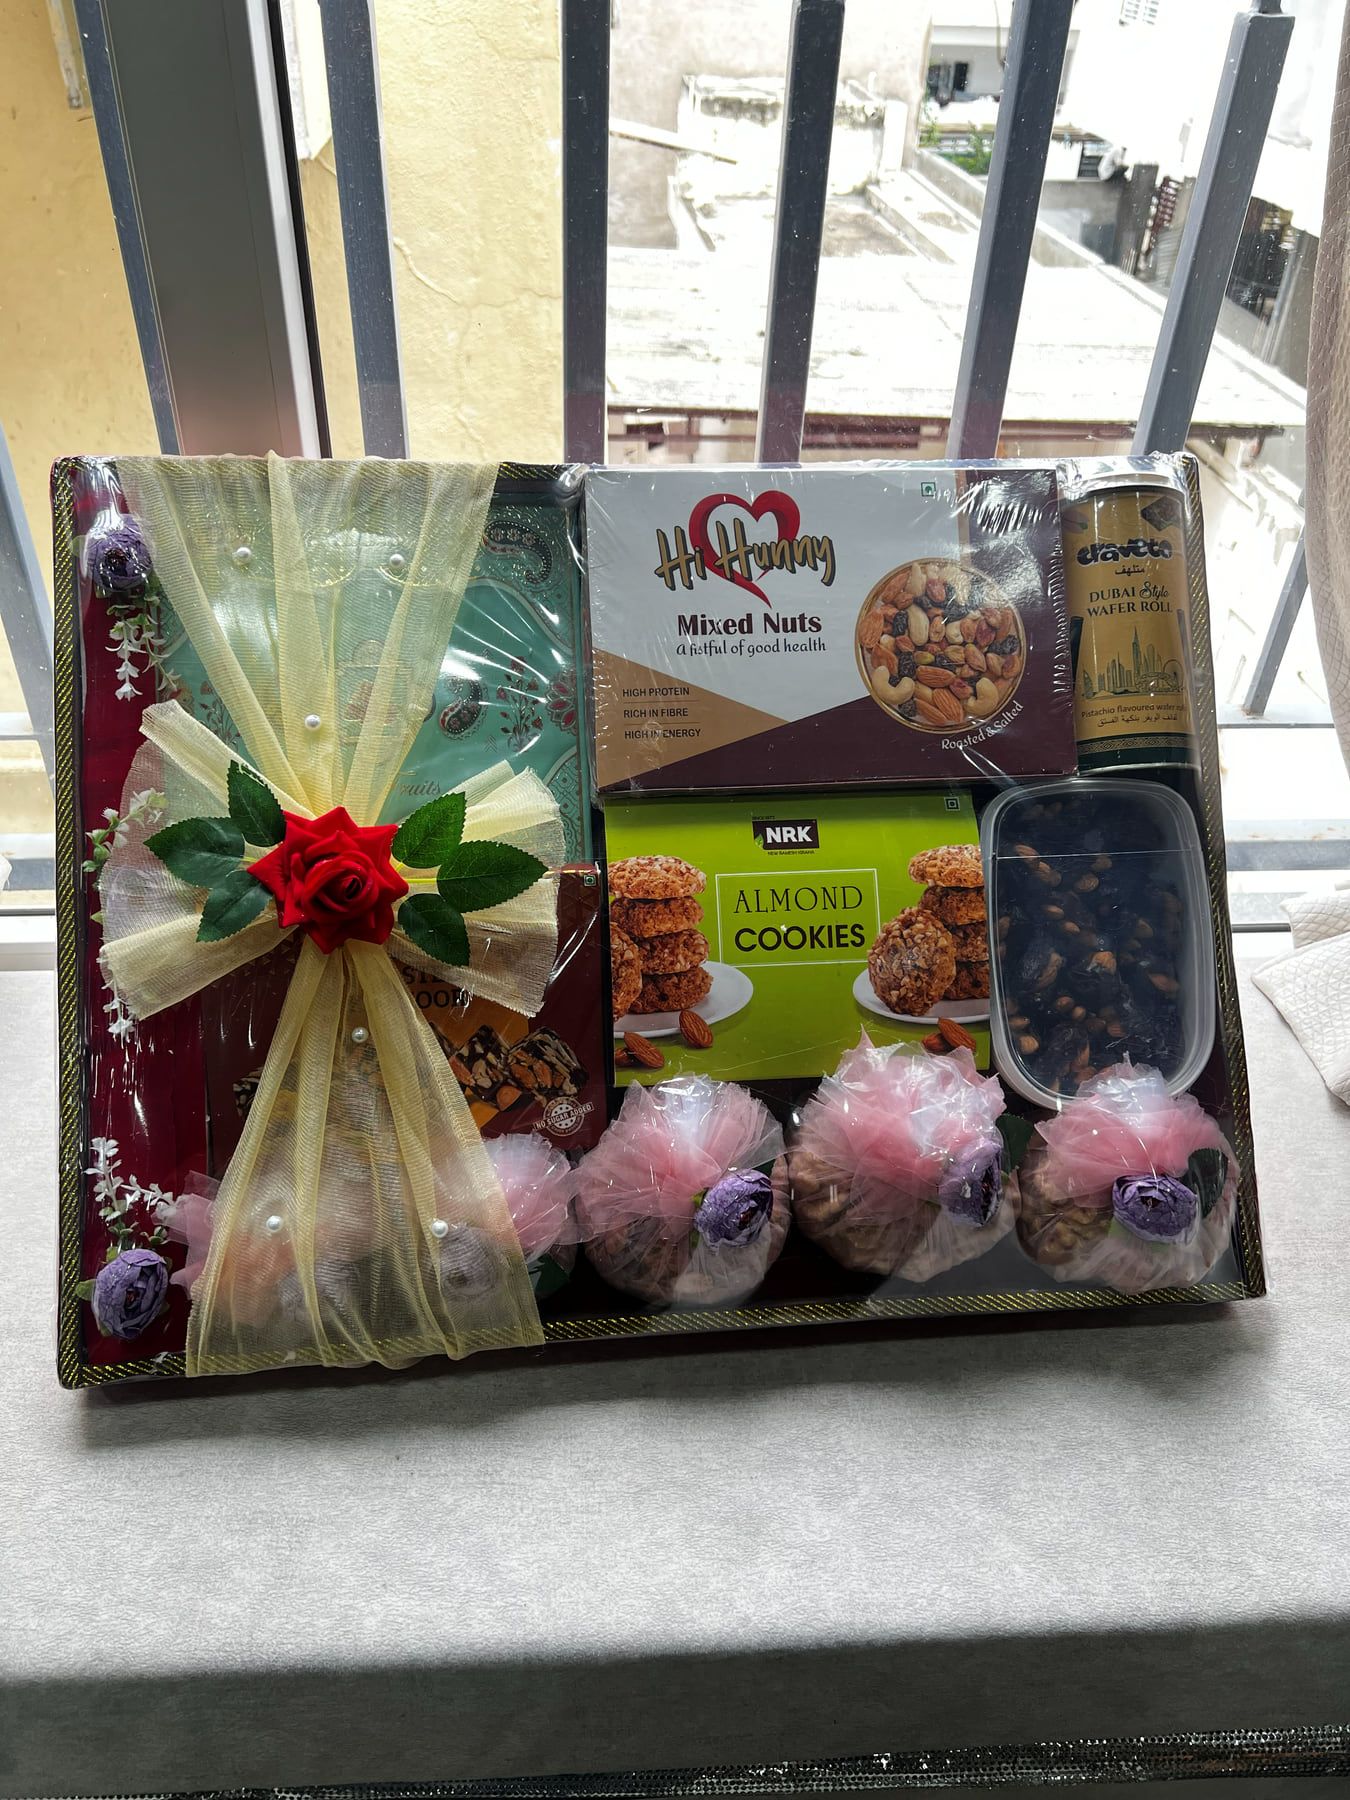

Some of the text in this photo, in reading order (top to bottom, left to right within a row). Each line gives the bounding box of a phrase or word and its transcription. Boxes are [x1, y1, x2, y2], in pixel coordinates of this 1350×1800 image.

[654, 518, 836, 591] Hi Hunny
[1089, 581, 1170, 603] DUBAI Style
[1087, 600, 1173, 617] WAFER ROLL
[677, 612, 822, 636] Mixed Nuts
[690, 639, 727, 656] fistful
[730, 639, 746, 656] of
[748, 638, 780, 658] good
[783, 637, 826, 653] health
[622, 687, 690, 697] HIGH PROTEIN
[623, 708, 689, 718] RICH IN FIBRE
[1081, 706, 1115, 718] Pistachio
[1117, 704, 1155, 713] flavoured
[624, 730, 648, 739] HIGH
[662, 729, 701, 738] ENERGY
[941, 728, 986, 750] Roasted
[993, 700, 1024, 730] Salted
[766, 826, 813, 843] NRK
[733, 886, 863, 914] ALMOND
[735, 924, 866, 952] COOKIES
[535, 1119, 546, 1130] NO
[546, 1112, 570, 1126] SUGAR
